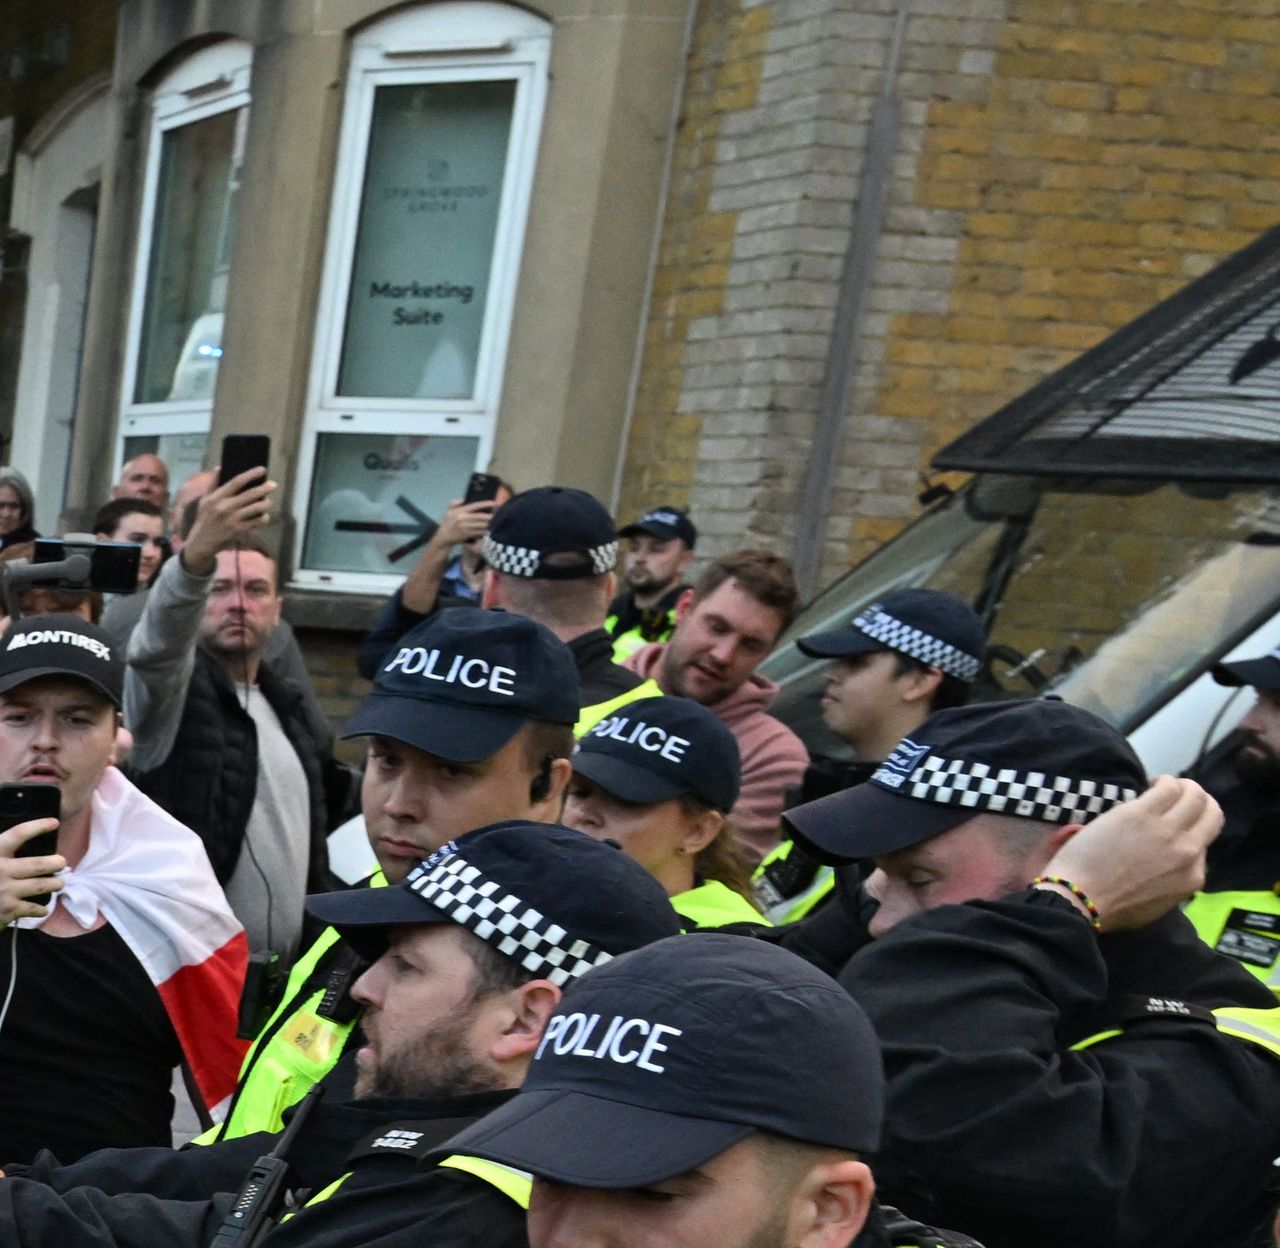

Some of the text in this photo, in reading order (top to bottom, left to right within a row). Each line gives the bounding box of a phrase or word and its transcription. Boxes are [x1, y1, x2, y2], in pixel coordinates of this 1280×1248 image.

[369, 281, 476, 304] Marketing
[393, 306, 444, 326] Suite
[6, 629, 111, 661] MONTIREX
[384, 647, 517, 696] POLICE
[534, 1012, 683, 1074] POLICE
